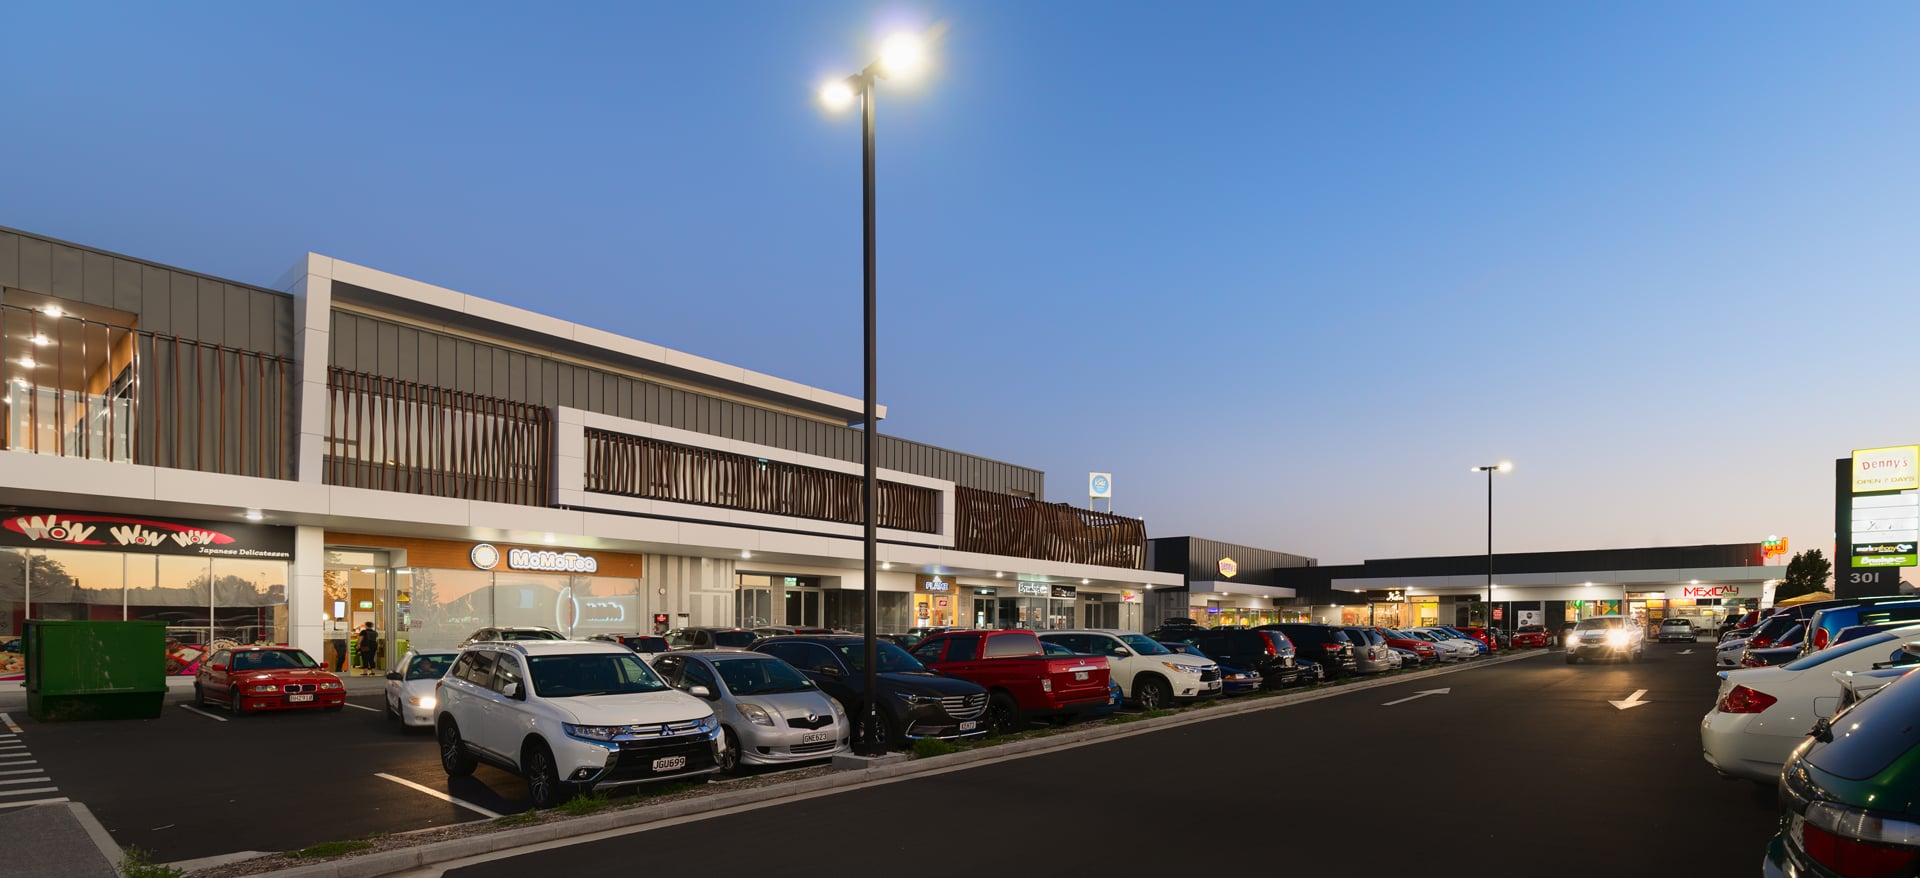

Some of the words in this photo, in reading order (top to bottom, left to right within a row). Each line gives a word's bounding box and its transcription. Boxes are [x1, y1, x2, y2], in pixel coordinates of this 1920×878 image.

[198, 547, 237, 555] Japanese
[239, 549, 289, 557] Delicatessen
[1850, 572, 1879, 583] 301
[804, 733, 827, 743] GNE623
[653, 757, 685, 769] JGU699
